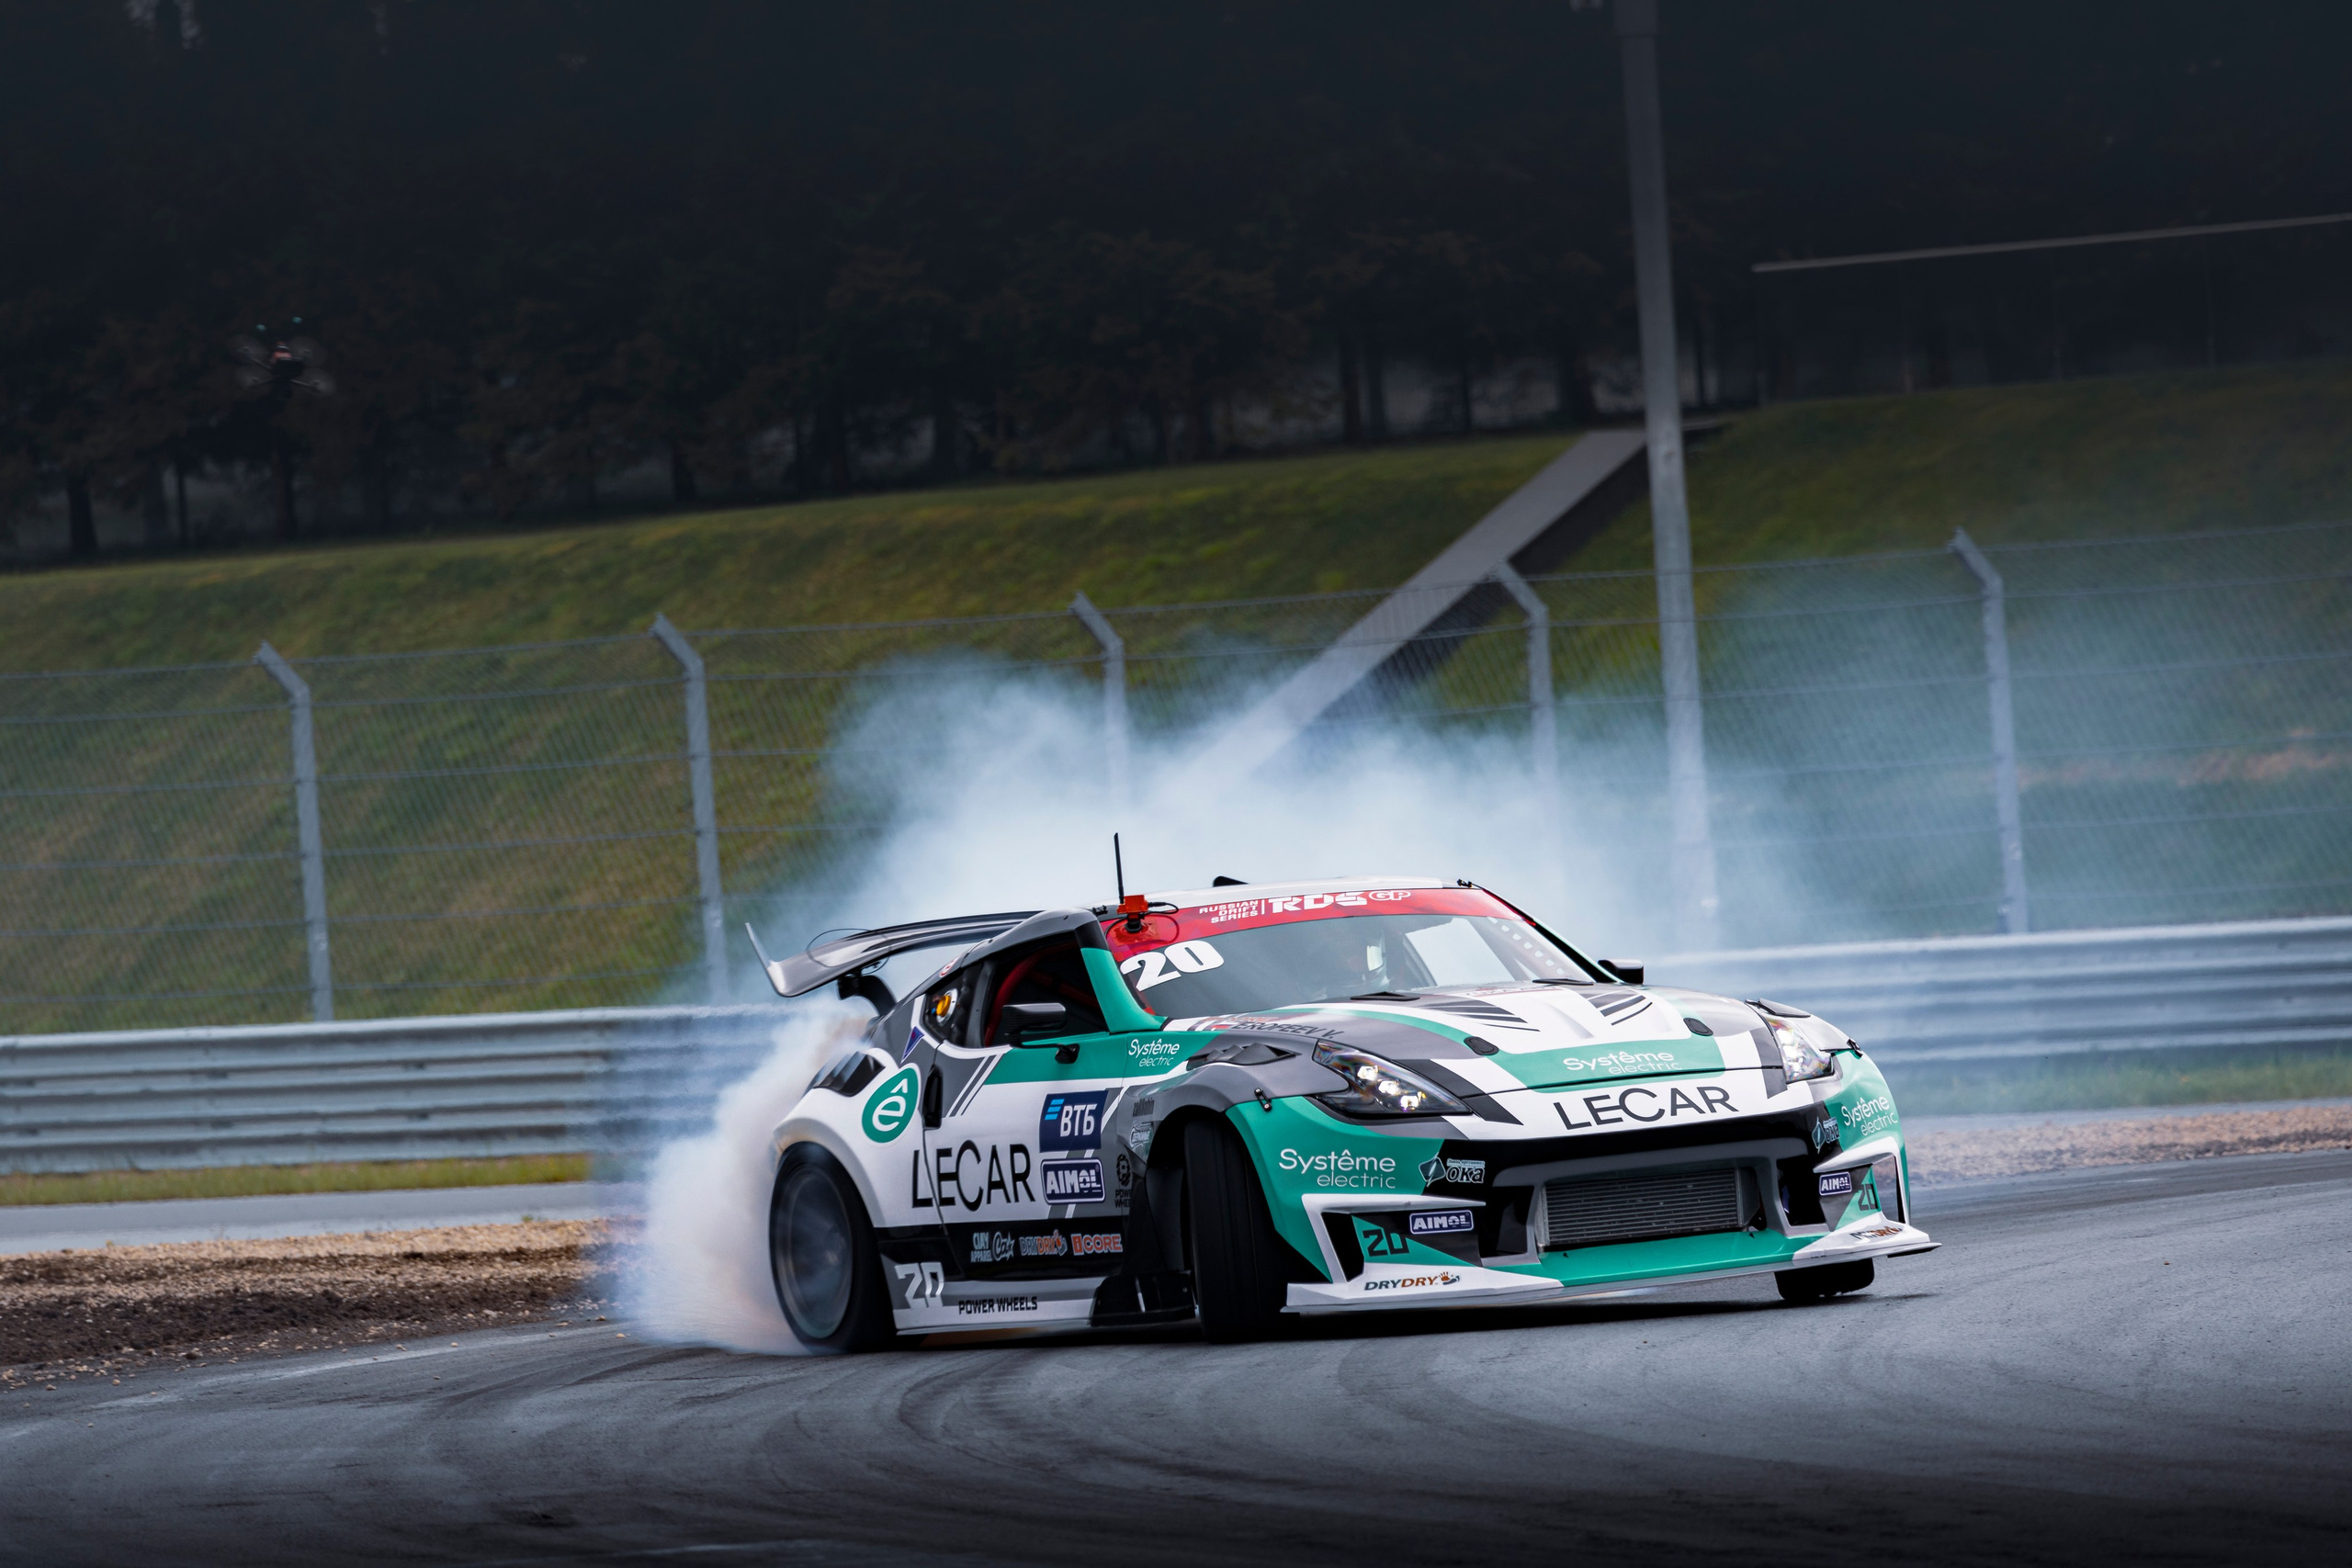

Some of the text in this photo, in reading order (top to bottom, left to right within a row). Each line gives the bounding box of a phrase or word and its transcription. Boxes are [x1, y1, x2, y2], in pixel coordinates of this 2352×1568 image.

[1199, 899, 1259, 915] RUSSIAN
[1218, 905, 1259, 918] DRIFT
[1268, 889, 1411, 914] RDS GP
[1211, 910, 1259, 924] SERIES
[1120, 940, 1225, 992] 20
[1231, 1021, 1326, 1036] EROFEEV
[1128, 1038, 1181, 1058] Systême
[1138, 1055, 1174, 1067] electric
[1563, 1051, 1675, 1071] Systême
[1608, 1060, 1682, 1075] electric
[1554, 1086, 1740, 1130] LECAR
[1841, 1096, 1890, 1128] Systême
[1059, 1103, 1098, 1137] ВТБ
[1860, 1111, 1899, 1136] electric
[1278, 1148, 1396, 1174] Systême
[912, 1139, 1036, 1212] LECAR
[1046, 1169, 1102, 1195] AIMOL
[1317, 1170, 1396, 1189] electric
[1821, 1175, 1851, 1192] AIMOL
[1858, 1183, 1879, 1212] 20
[1413, 1214, 1471, 1232] AIMOL
[1362, 1228, 1410, 1258] 20
[894, 1261, 945, 1310] 20
[1364, 1275, 1439, 1291] DRYDRY
[958, 1295, 1038, 1314] POWER WHEELS
